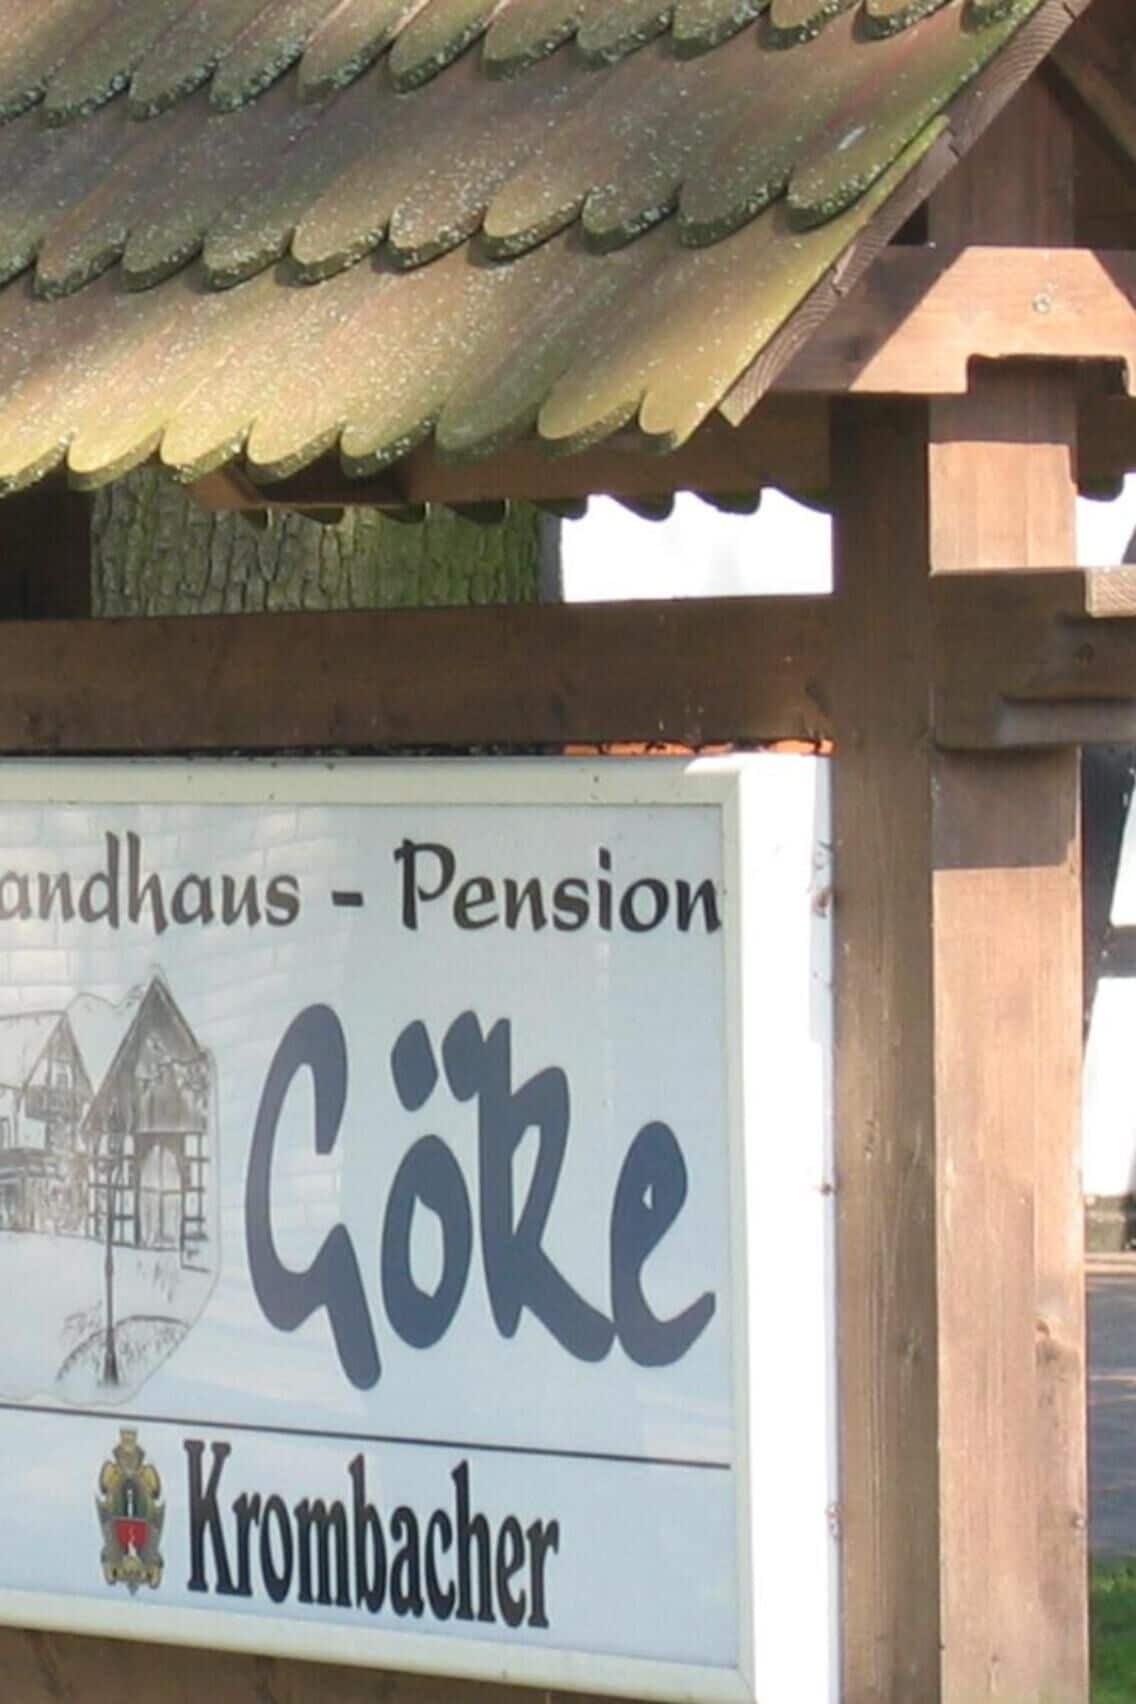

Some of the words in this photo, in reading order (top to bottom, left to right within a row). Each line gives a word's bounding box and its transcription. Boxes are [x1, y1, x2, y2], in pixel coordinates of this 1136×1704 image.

[330, 889, 365, 909] -
[392, 837, 722, 935] Pension
[183, 1438, 560, 1629] Krombacher
